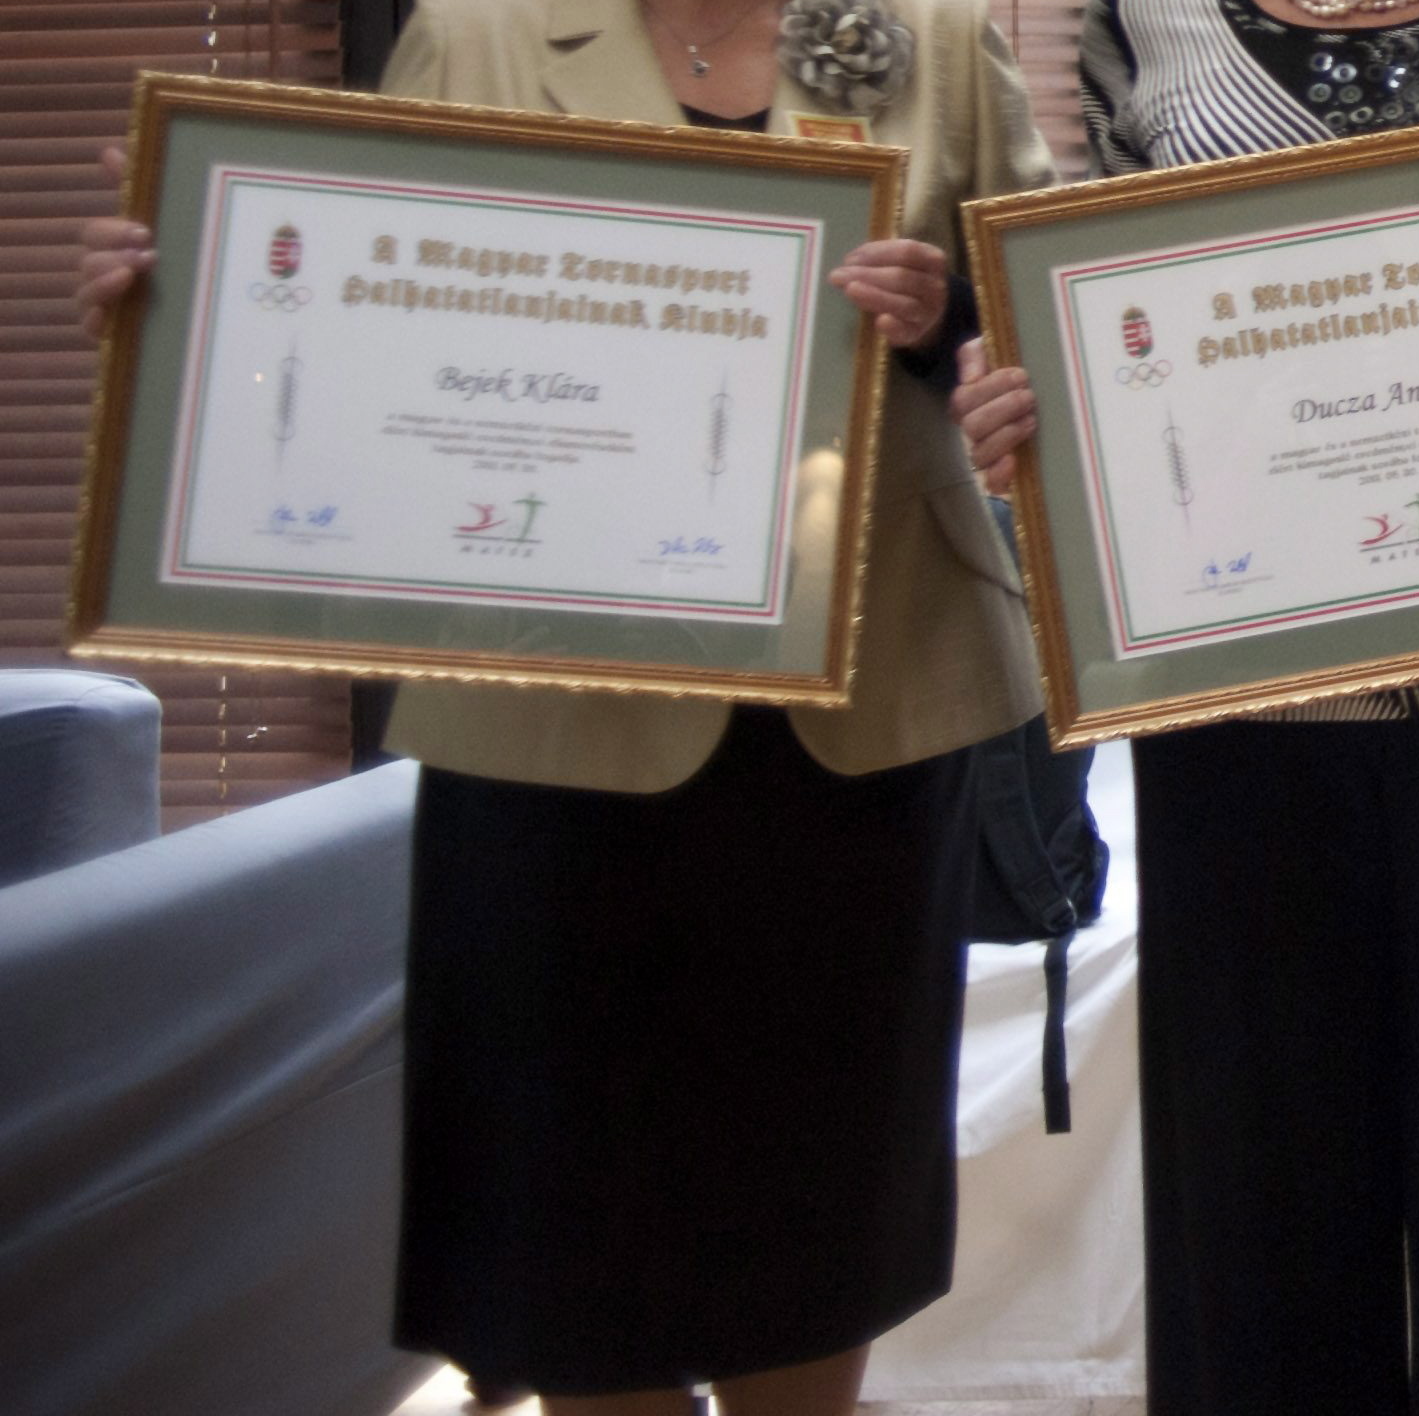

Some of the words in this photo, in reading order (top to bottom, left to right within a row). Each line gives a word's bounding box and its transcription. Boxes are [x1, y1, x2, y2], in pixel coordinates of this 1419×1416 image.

[372, 235, 397, 264] A
[417, 238, 550, 277] Magyar
[559, 252, 750, 295] Tornasport
[1212, 291, 1237, 321] A
[1252, 272, 1373, 313] Magyar
[659, 303, 770, 340] Klubja
[436, 366, 516, 402] Bejek
[521, 373, 600, 403] Klára
[1292, 393, 1377, 423] Ducza
